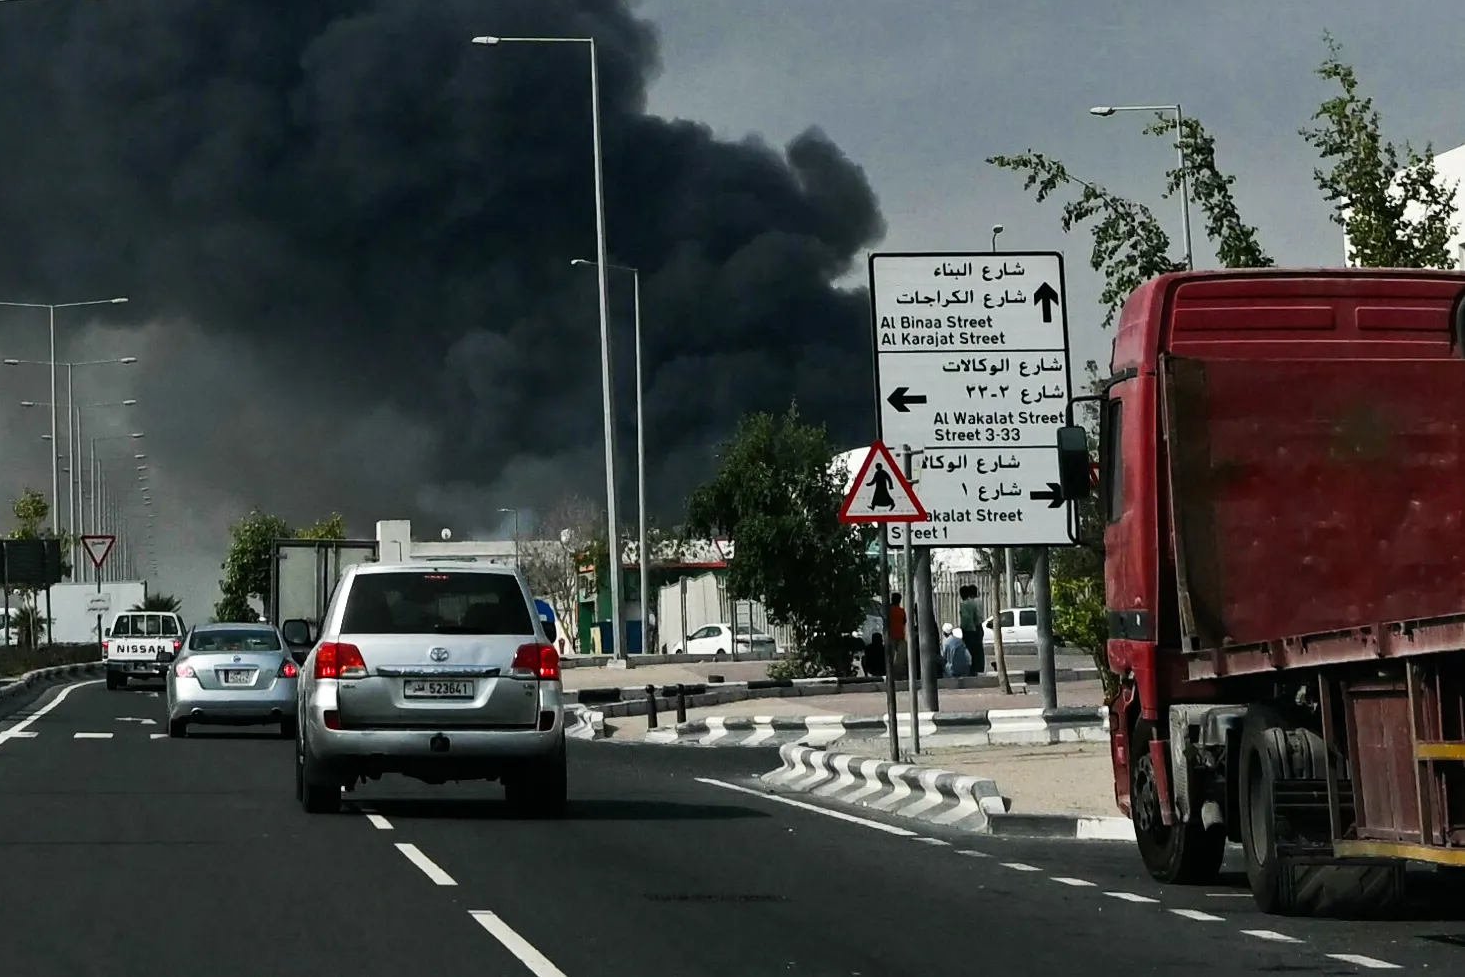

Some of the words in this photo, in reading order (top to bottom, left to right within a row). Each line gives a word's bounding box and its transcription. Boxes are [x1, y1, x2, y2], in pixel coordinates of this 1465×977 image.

[933, 262, 972, 278] البناء
[981, 262, 1025, 282] شارع
[896, 289, 974, 308] الكراجات
[983, 289, 1027, 309] شارع
[880, 316, 896, 329] Al
[900, 315, 942, 329] Binaa
[946, 315, 993, 329] Street
[881, 332, 897, 346] Al
[901, 331, 955, 348] Karajat
[959, 331, 1006, 345] Street
[942, 357, 1010, 376] الوكالات
[1019, 357, 1063, 377] شارع
[1020, 384, 1064, 404] شارع
[933, 411, 949, 425] Al
[953, 411, 1014, 425] Wakalat
[1018, 411, 1065, 425] Street
[934, 428, 981, 442] Street
[985, 428, 1021, 442] 3-33
[976, 454, 1021, 474] شارع
[961, 482, 968, 496] ١
[978, 482, 1022, 502] شارع
[925, 508, 972, 522] akalat
[976, 508, 1023, 522] Street
[891, 525, 938, 539] Sreet
[942, 525, 948, 539] 1
[116, 644, 166, 654] NISSAN
[429, 683, 467, 694] 523641
